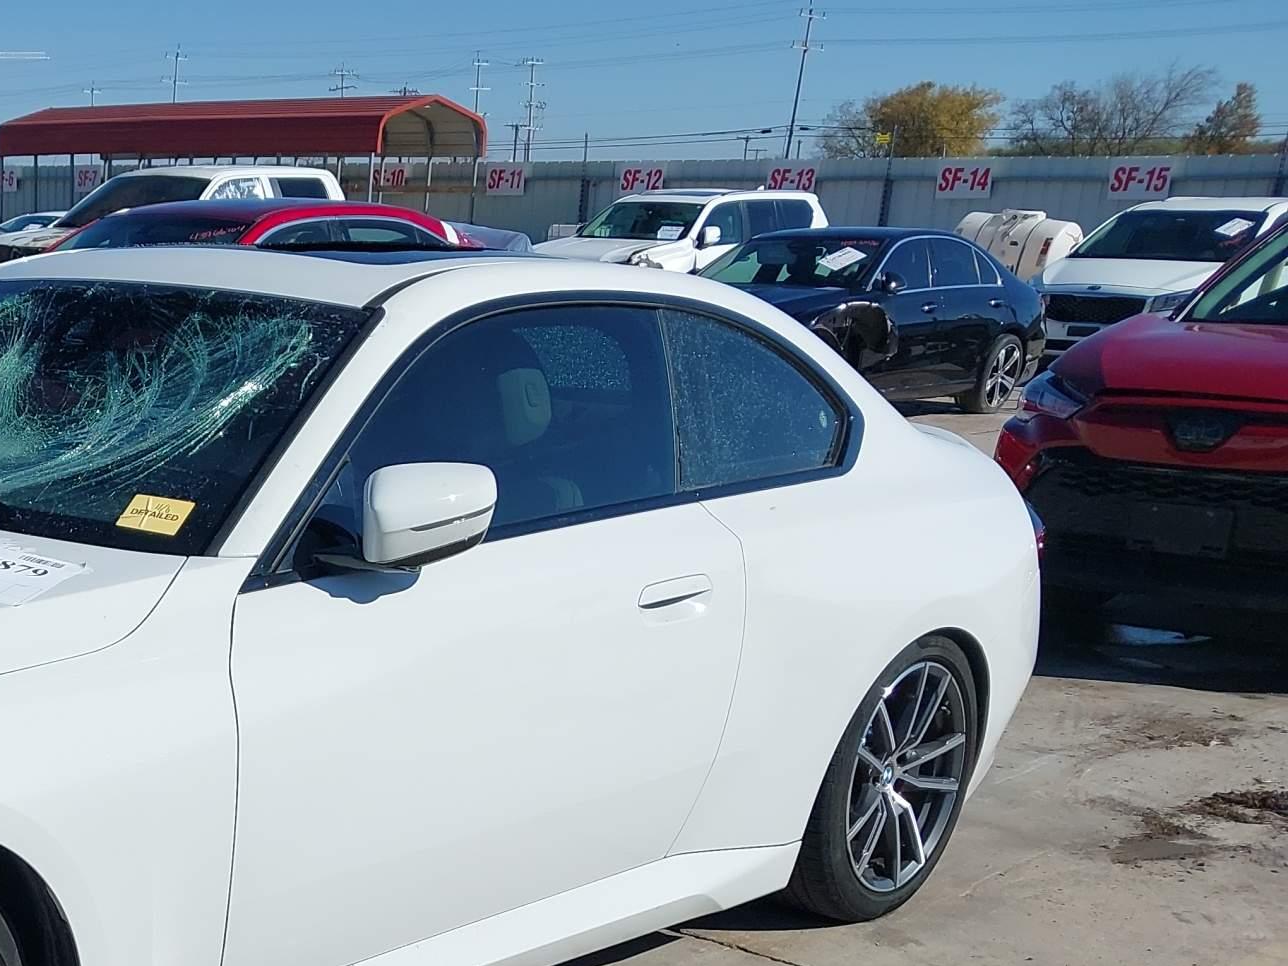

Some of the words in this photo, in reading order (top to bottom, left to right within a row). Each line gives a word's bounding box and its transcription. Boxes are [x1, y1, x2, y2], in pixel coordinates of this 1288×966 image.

[78, 170, 98, 187] SF-7
[488, 169, 523, 190] SF-11
[621, 169, 662, 191] SF-12
[768, 168, 815, 190] SF-13
[938, 167, 991, 192] SF-14
[1110, 165, 1171, 192] SF-15
[130, 508, 179, 522] DETAILED
